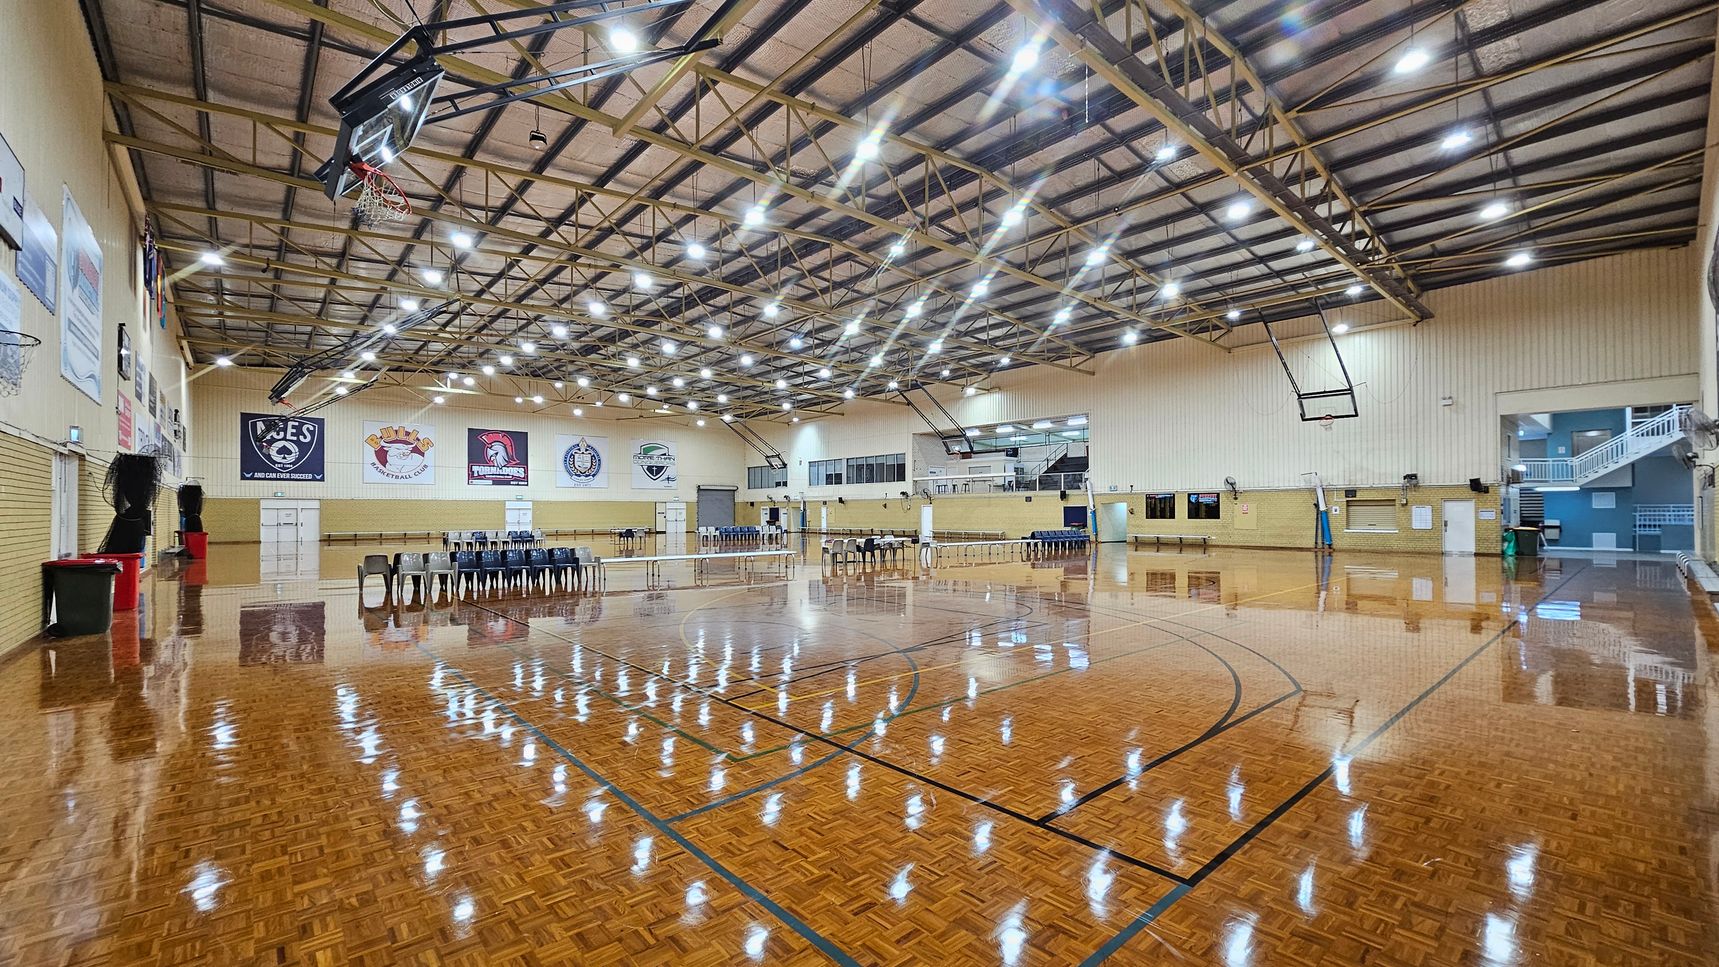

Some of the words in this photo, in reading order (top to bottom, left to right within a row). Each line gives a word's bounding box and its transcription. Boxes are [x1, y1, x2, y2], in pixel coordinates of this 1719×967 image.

[365, 425, 434, 452] BULLS
[370, 461, 413, 480] BASKETBALL
[413, 464, 429, 477] CLUB
[471, 465, 525, 478] TORNADOES
